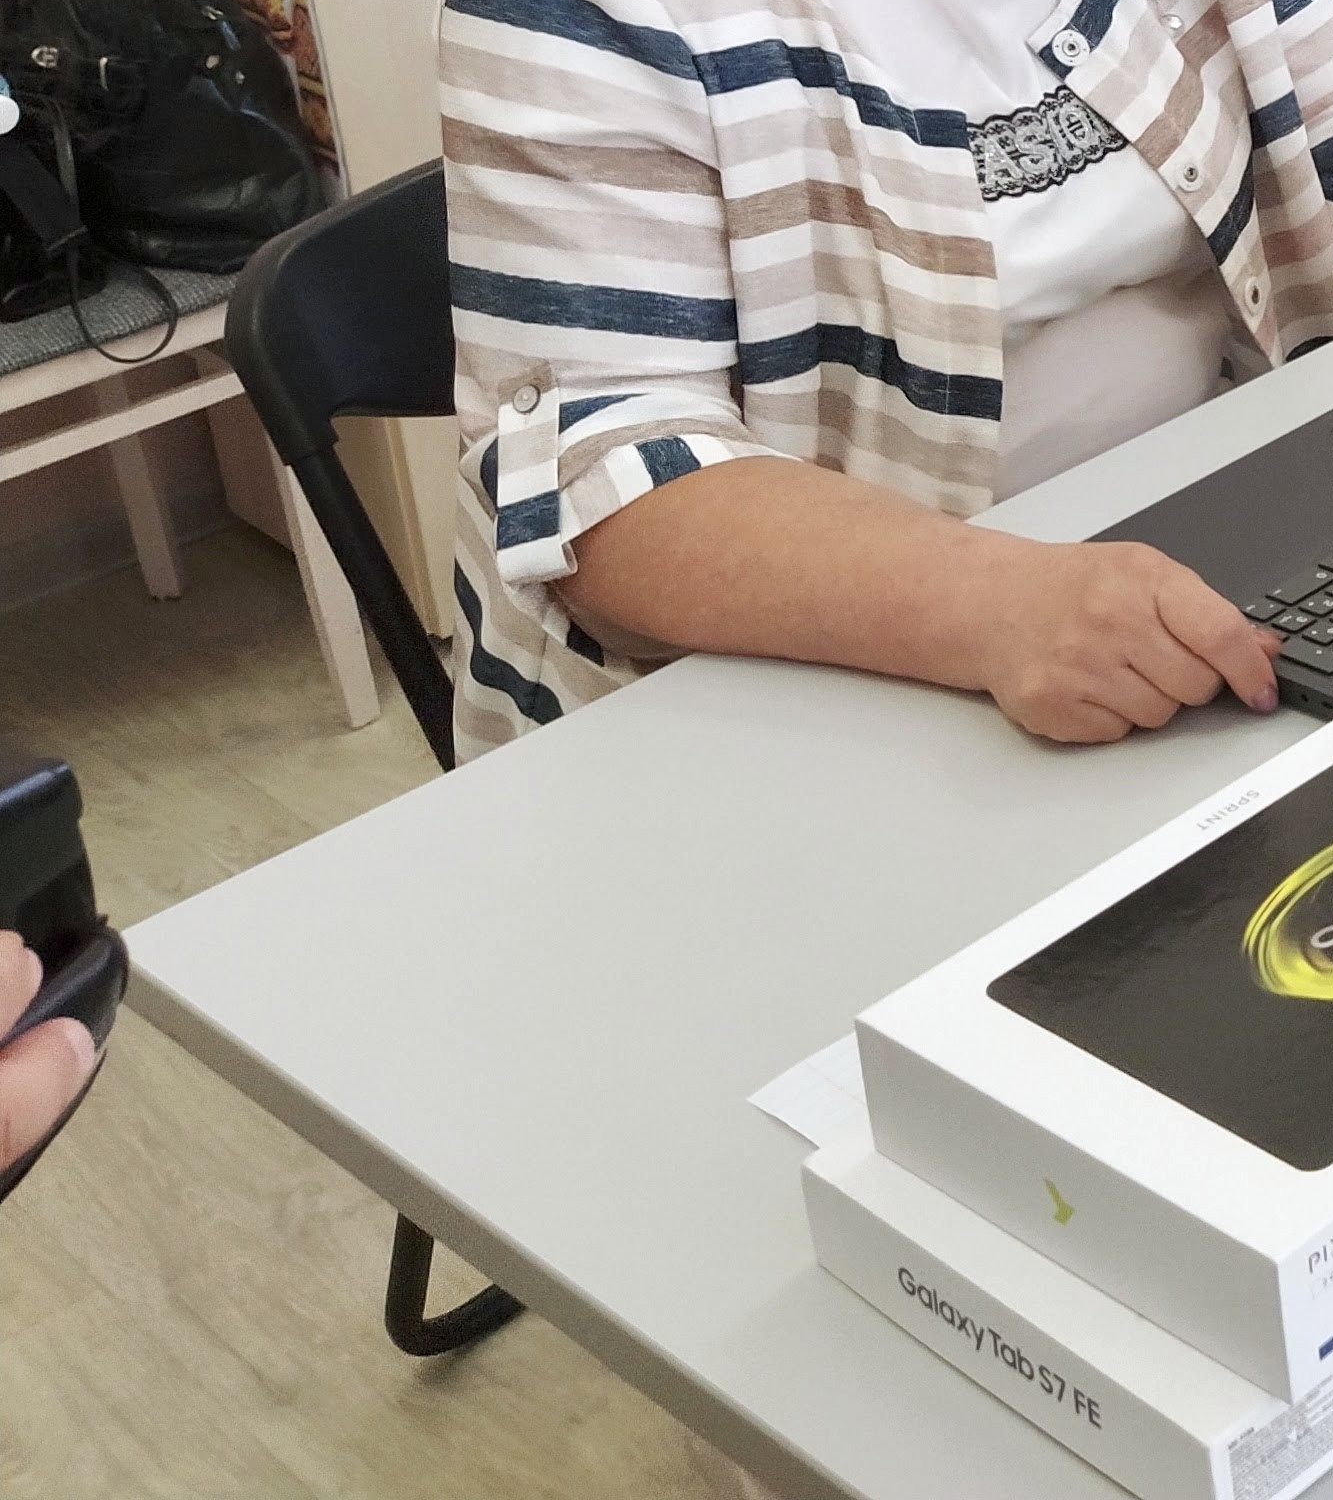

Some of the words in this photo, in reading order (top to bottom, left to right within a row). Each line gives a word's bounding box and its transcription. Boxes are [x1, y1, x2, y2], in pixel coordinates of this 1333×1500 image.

[1197, 789, 1260, 831] SPRINT
[898, 1267, 984, 1351] Galaxy
[988, 1326, 1035, 1381] Tab
[1038, 1364, 1066, 1402] S7
[1073, 1386, 1102, 1429] FE
